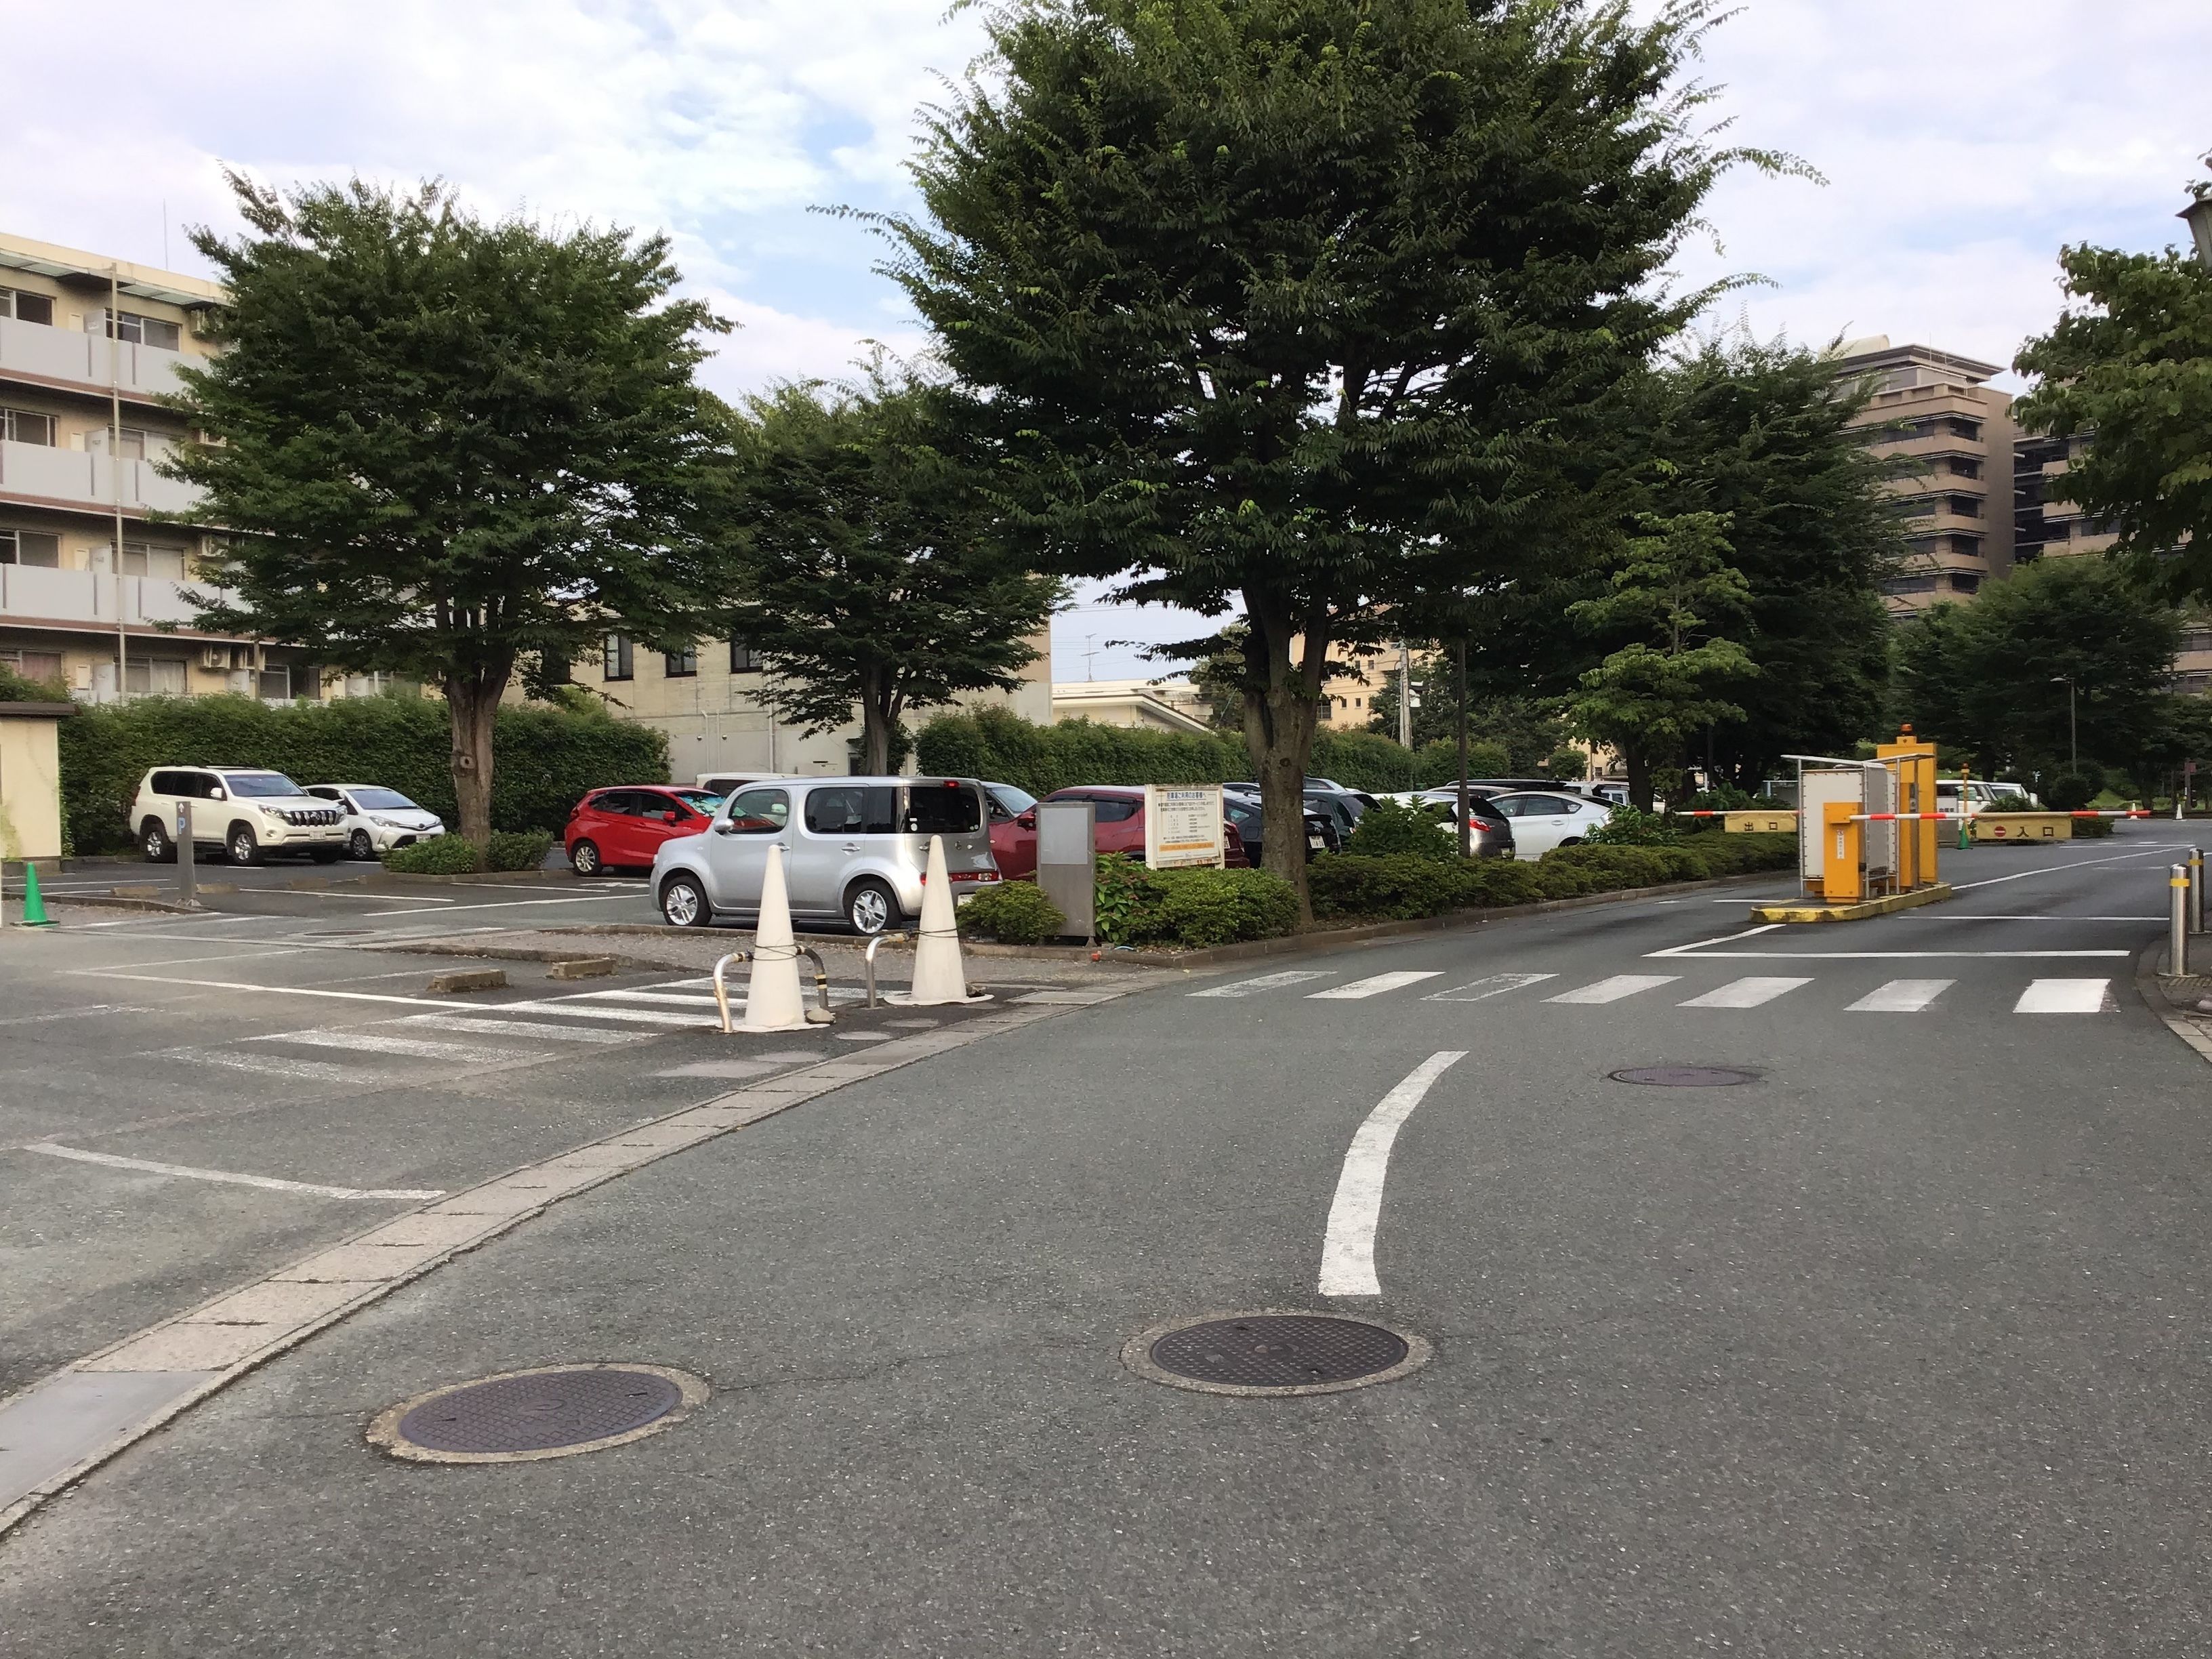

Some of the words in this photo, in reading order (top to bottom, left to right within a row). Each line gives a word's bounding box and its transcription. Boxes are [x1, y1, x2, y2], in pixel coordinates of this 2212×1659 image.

[178, 817, 185, 835] P
[1744, 821, 1778, 831] 出口
[2017, 826, 2054, 837] 入口
